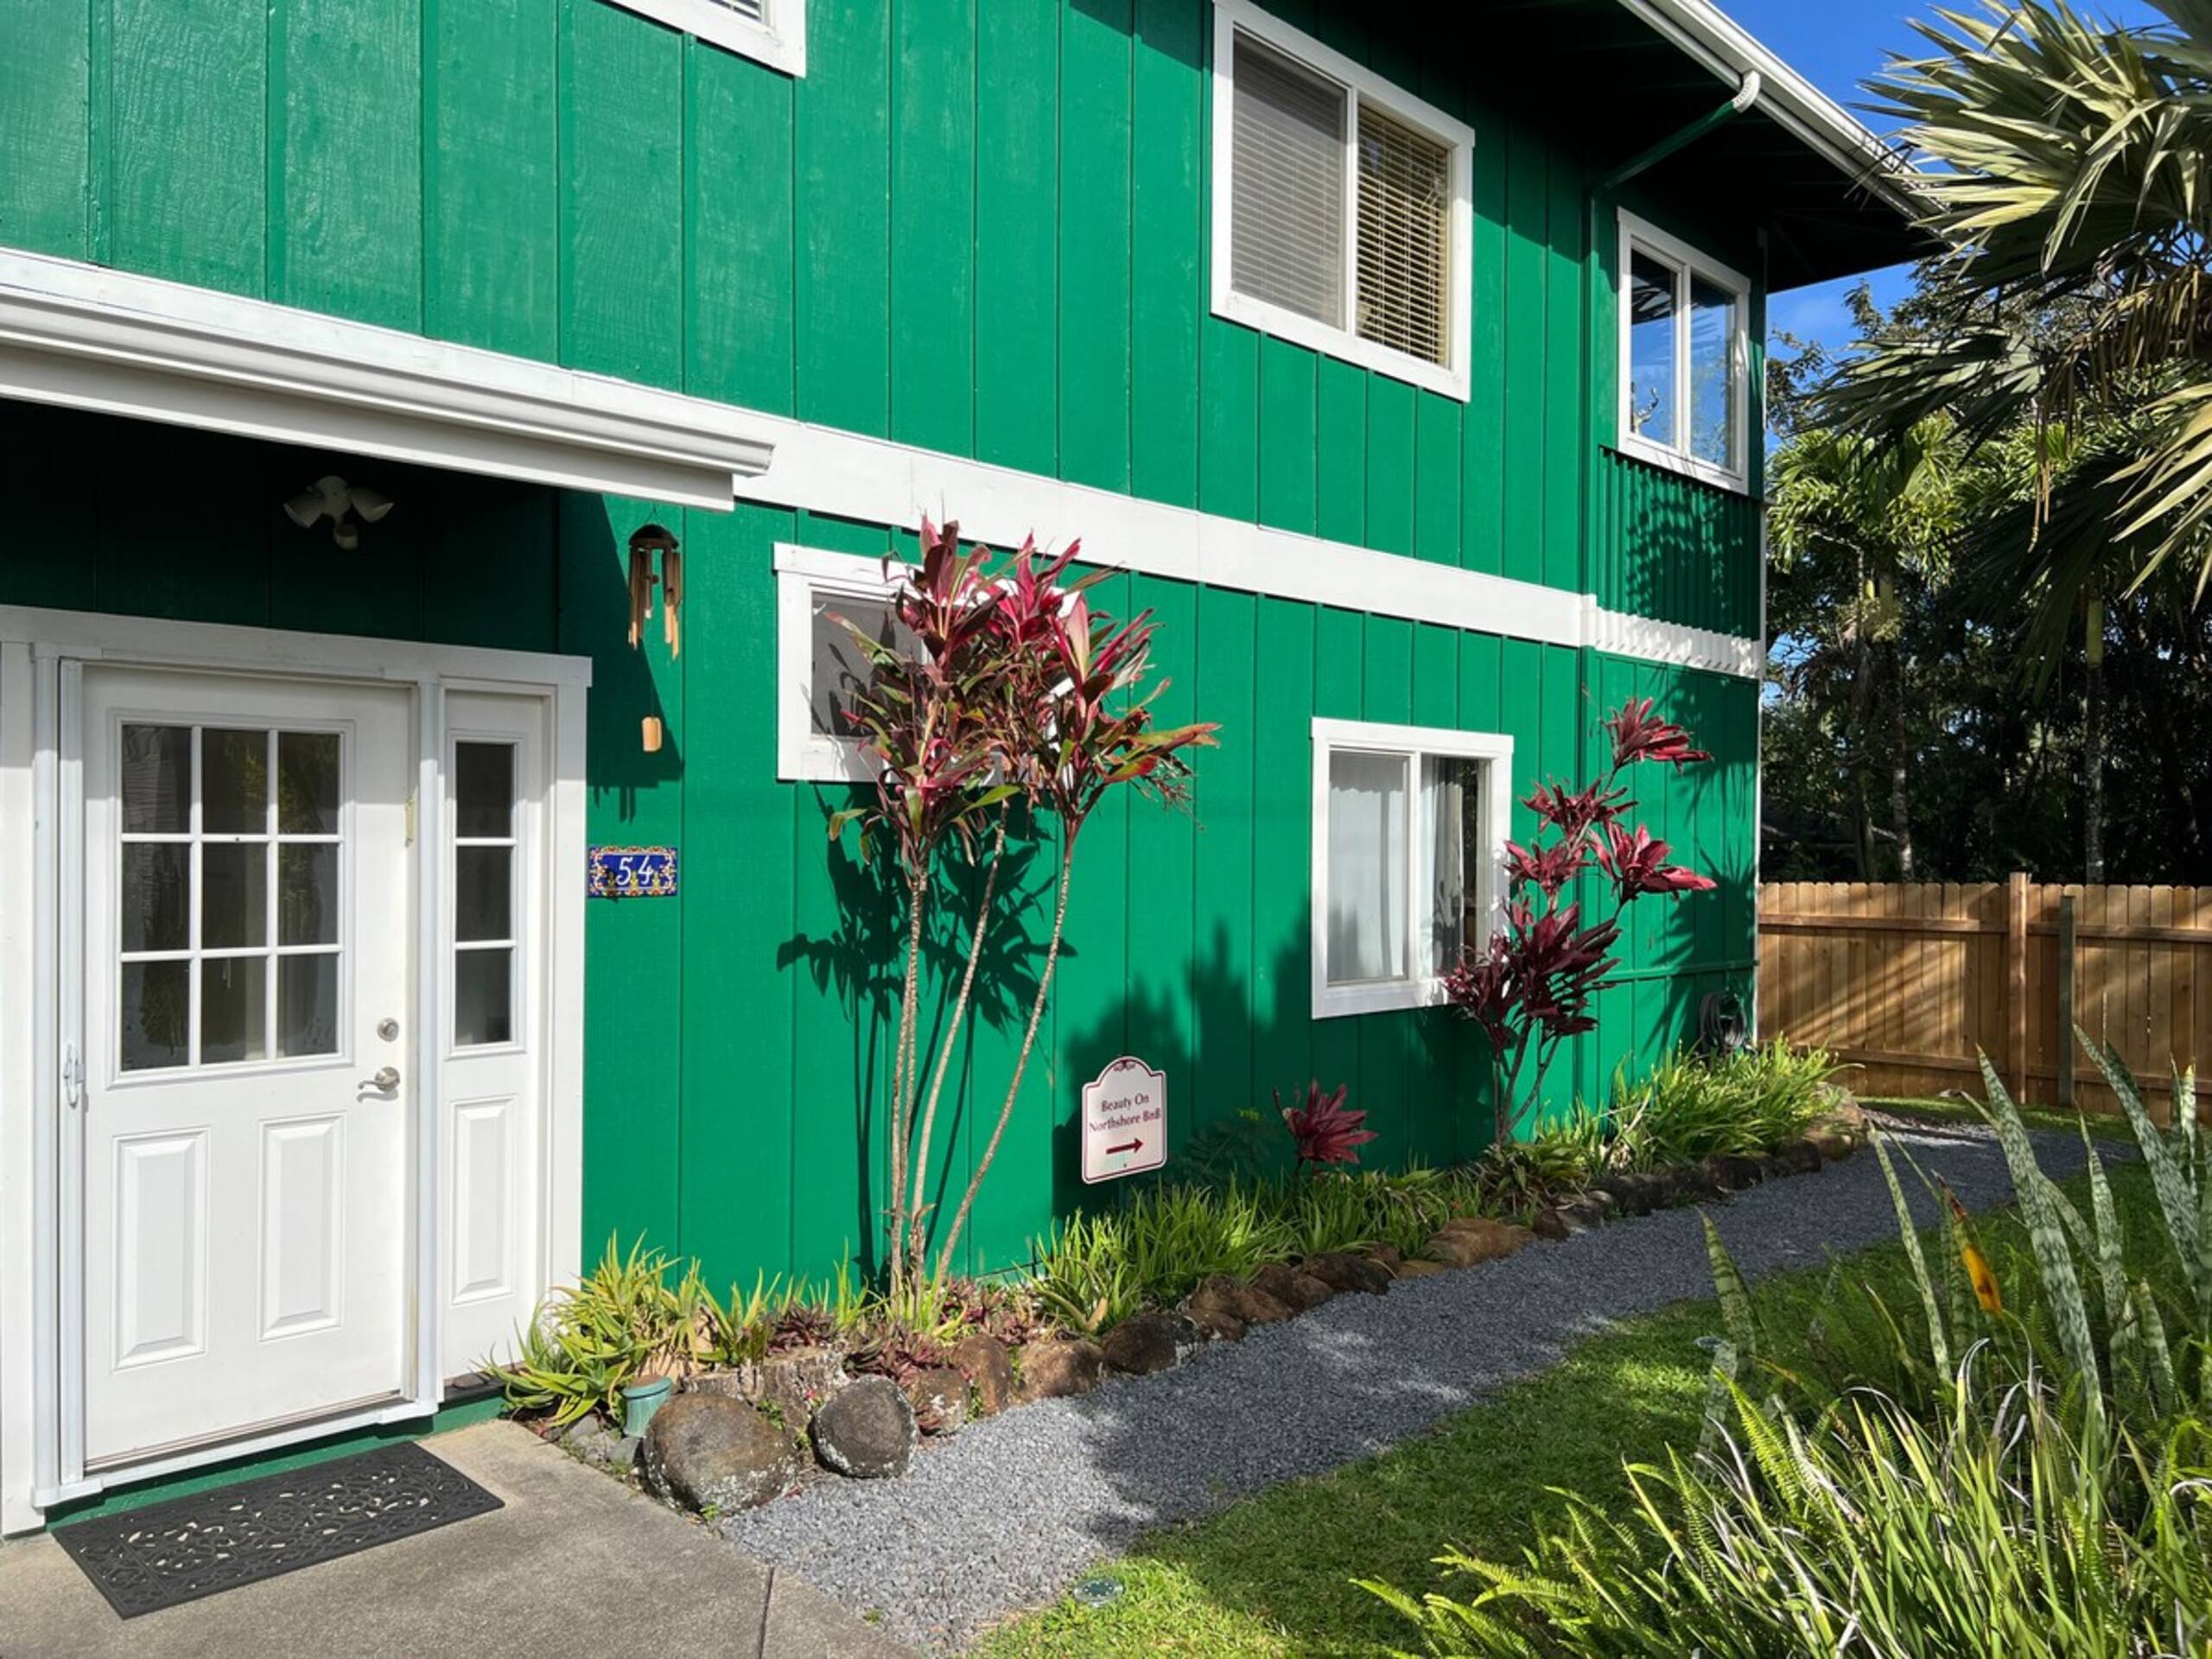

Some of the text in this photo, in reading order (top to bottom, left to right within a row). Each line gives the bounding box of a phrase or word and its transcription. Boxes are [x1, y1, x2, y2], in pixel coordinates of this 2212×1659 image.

[615, 855, 653, 885] 54
[1101, 1093, 1149, 1112] Beauty On
[1090, 1114, 1141, 1132] Northshore
